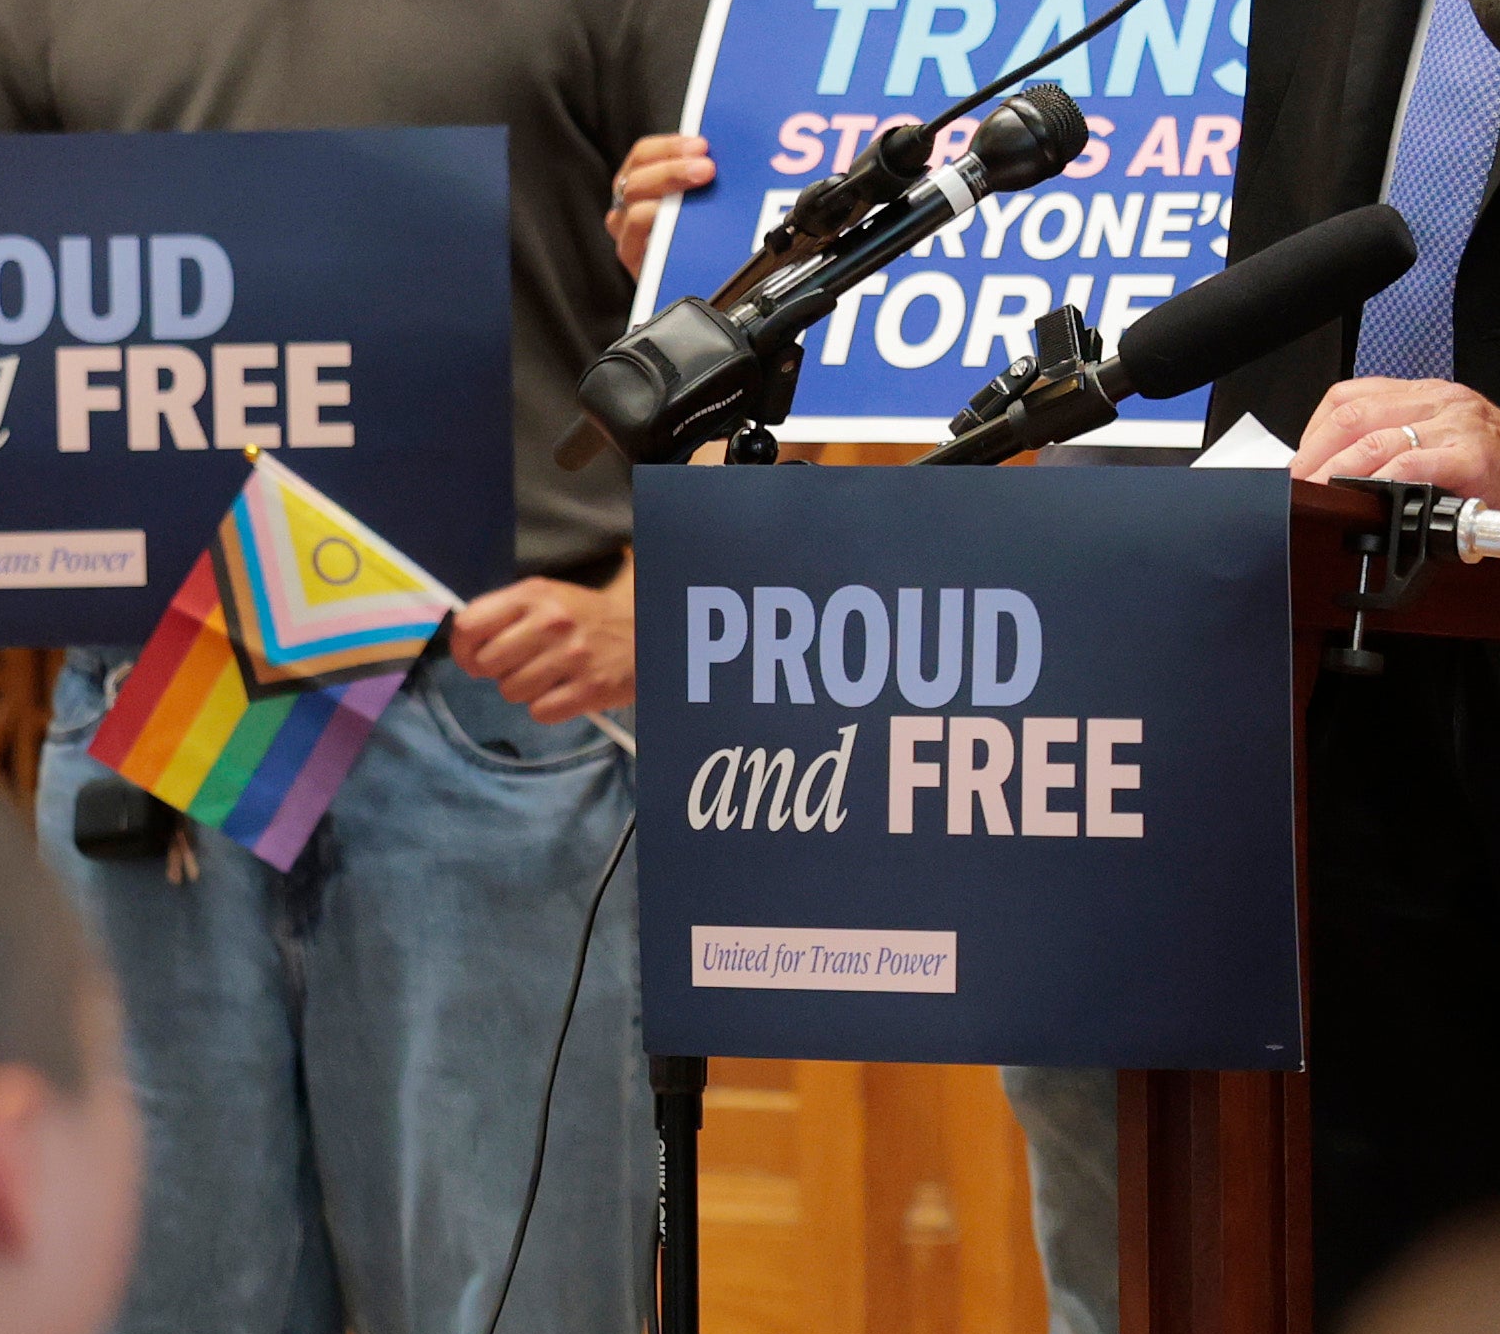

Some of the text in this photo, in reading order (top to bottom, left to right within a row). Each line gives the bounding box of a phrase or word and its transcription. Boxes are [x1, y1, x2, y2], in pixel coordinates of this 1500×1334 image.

[770, 112, 1242, 178] STRS AR
[750, 188, 1232, 260] ERYONE'
[794, 270, 1222, 369] TORE
[54, 341, 356, 453] FREE
[49, 546, 136, 575] Power
[686, 584, 1043, 708] PROUD
[686, 714, 1145, 839] and FREE
[703, 941, 948, 979] United for Trans Power
